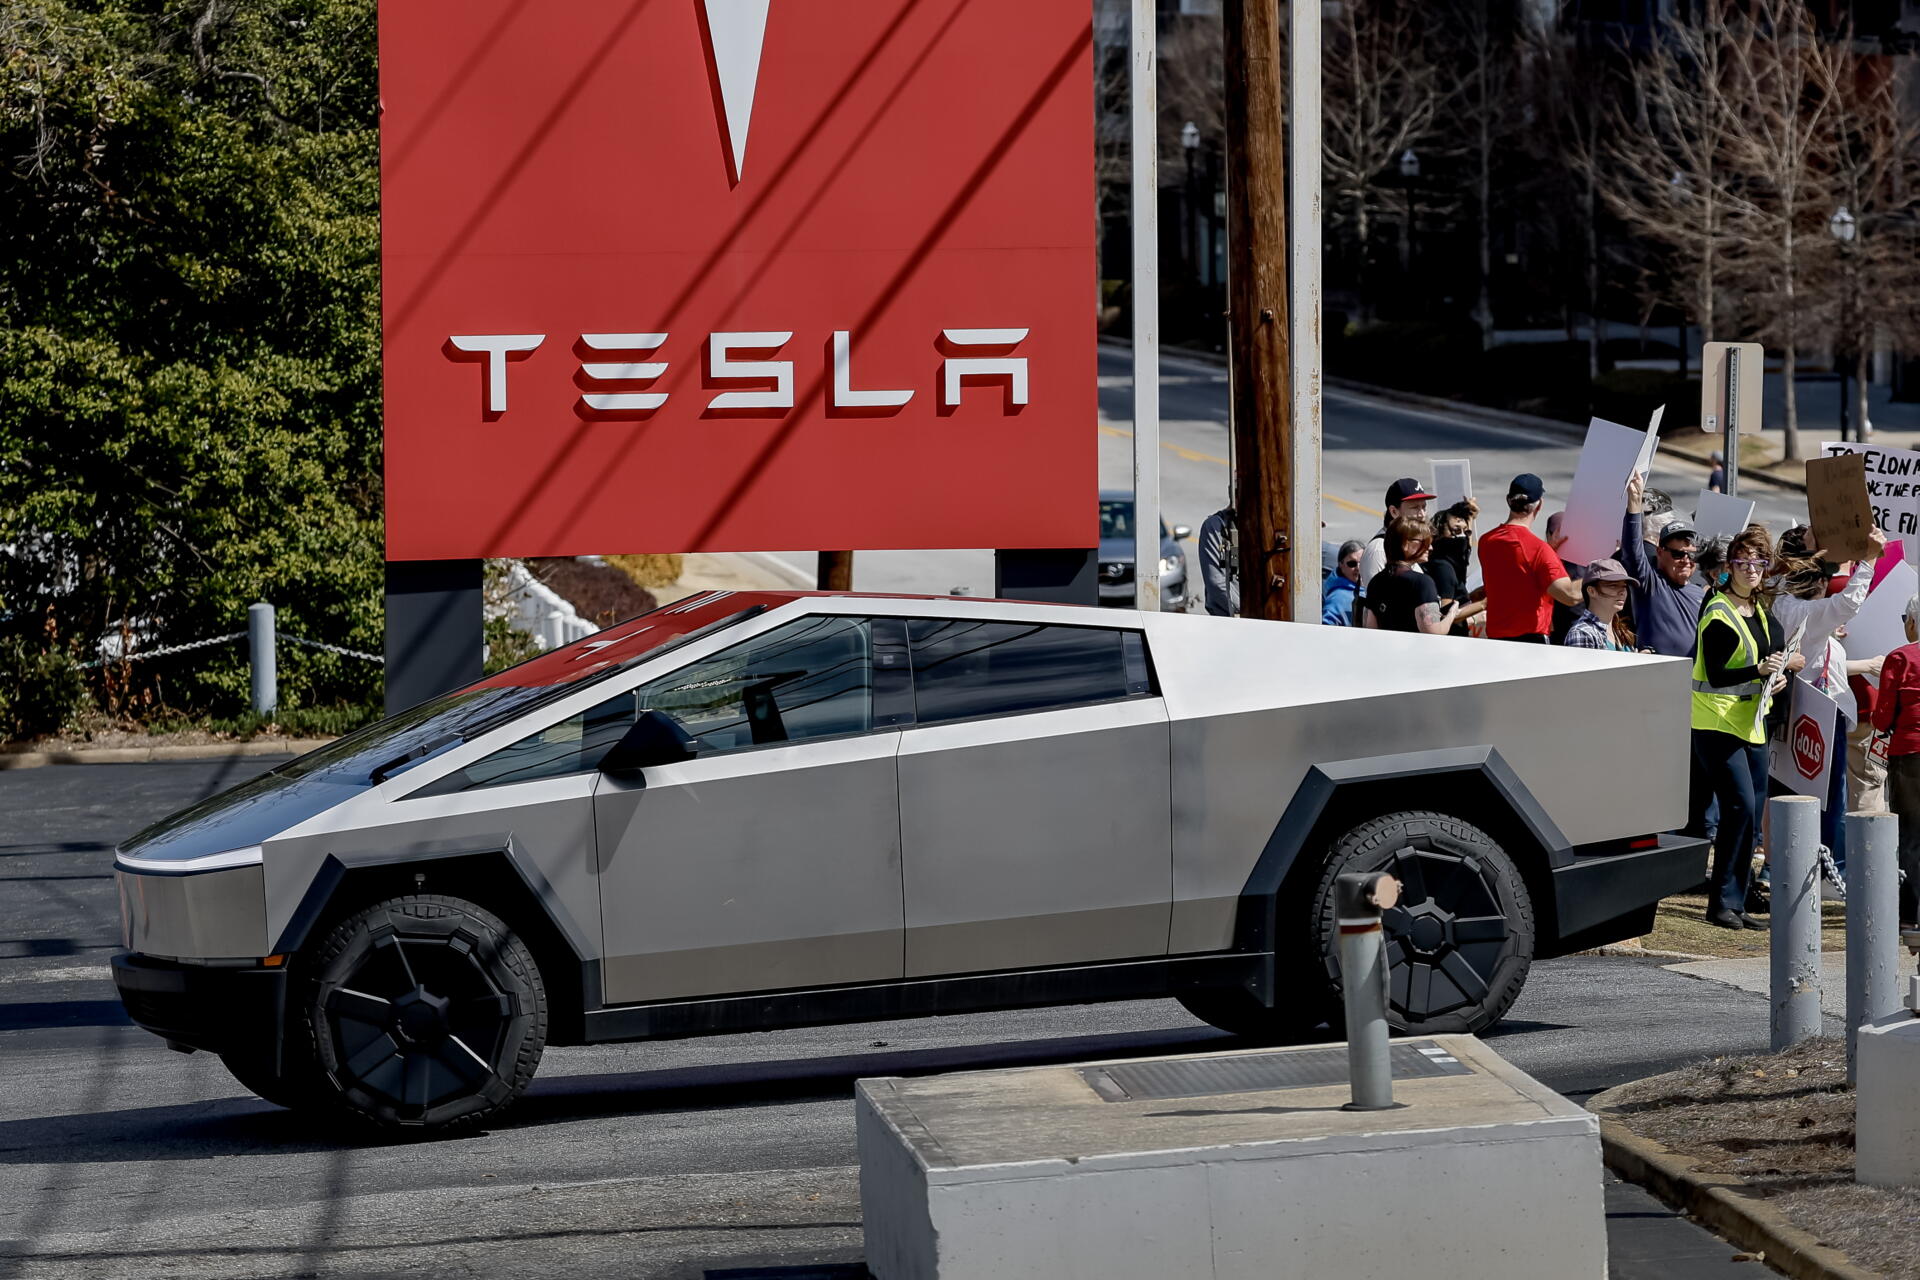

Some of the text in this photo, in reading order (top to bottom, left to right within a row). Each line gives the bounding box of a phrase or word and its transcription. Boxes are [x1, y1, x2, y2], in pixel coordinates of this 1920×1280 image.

[448, 327, 1030, 413] TESLA
[1864, 450, 1912, 476] ELON
[1884, 483, 1910, 497] THE
[1796, 732, 1821, 763] STOP
